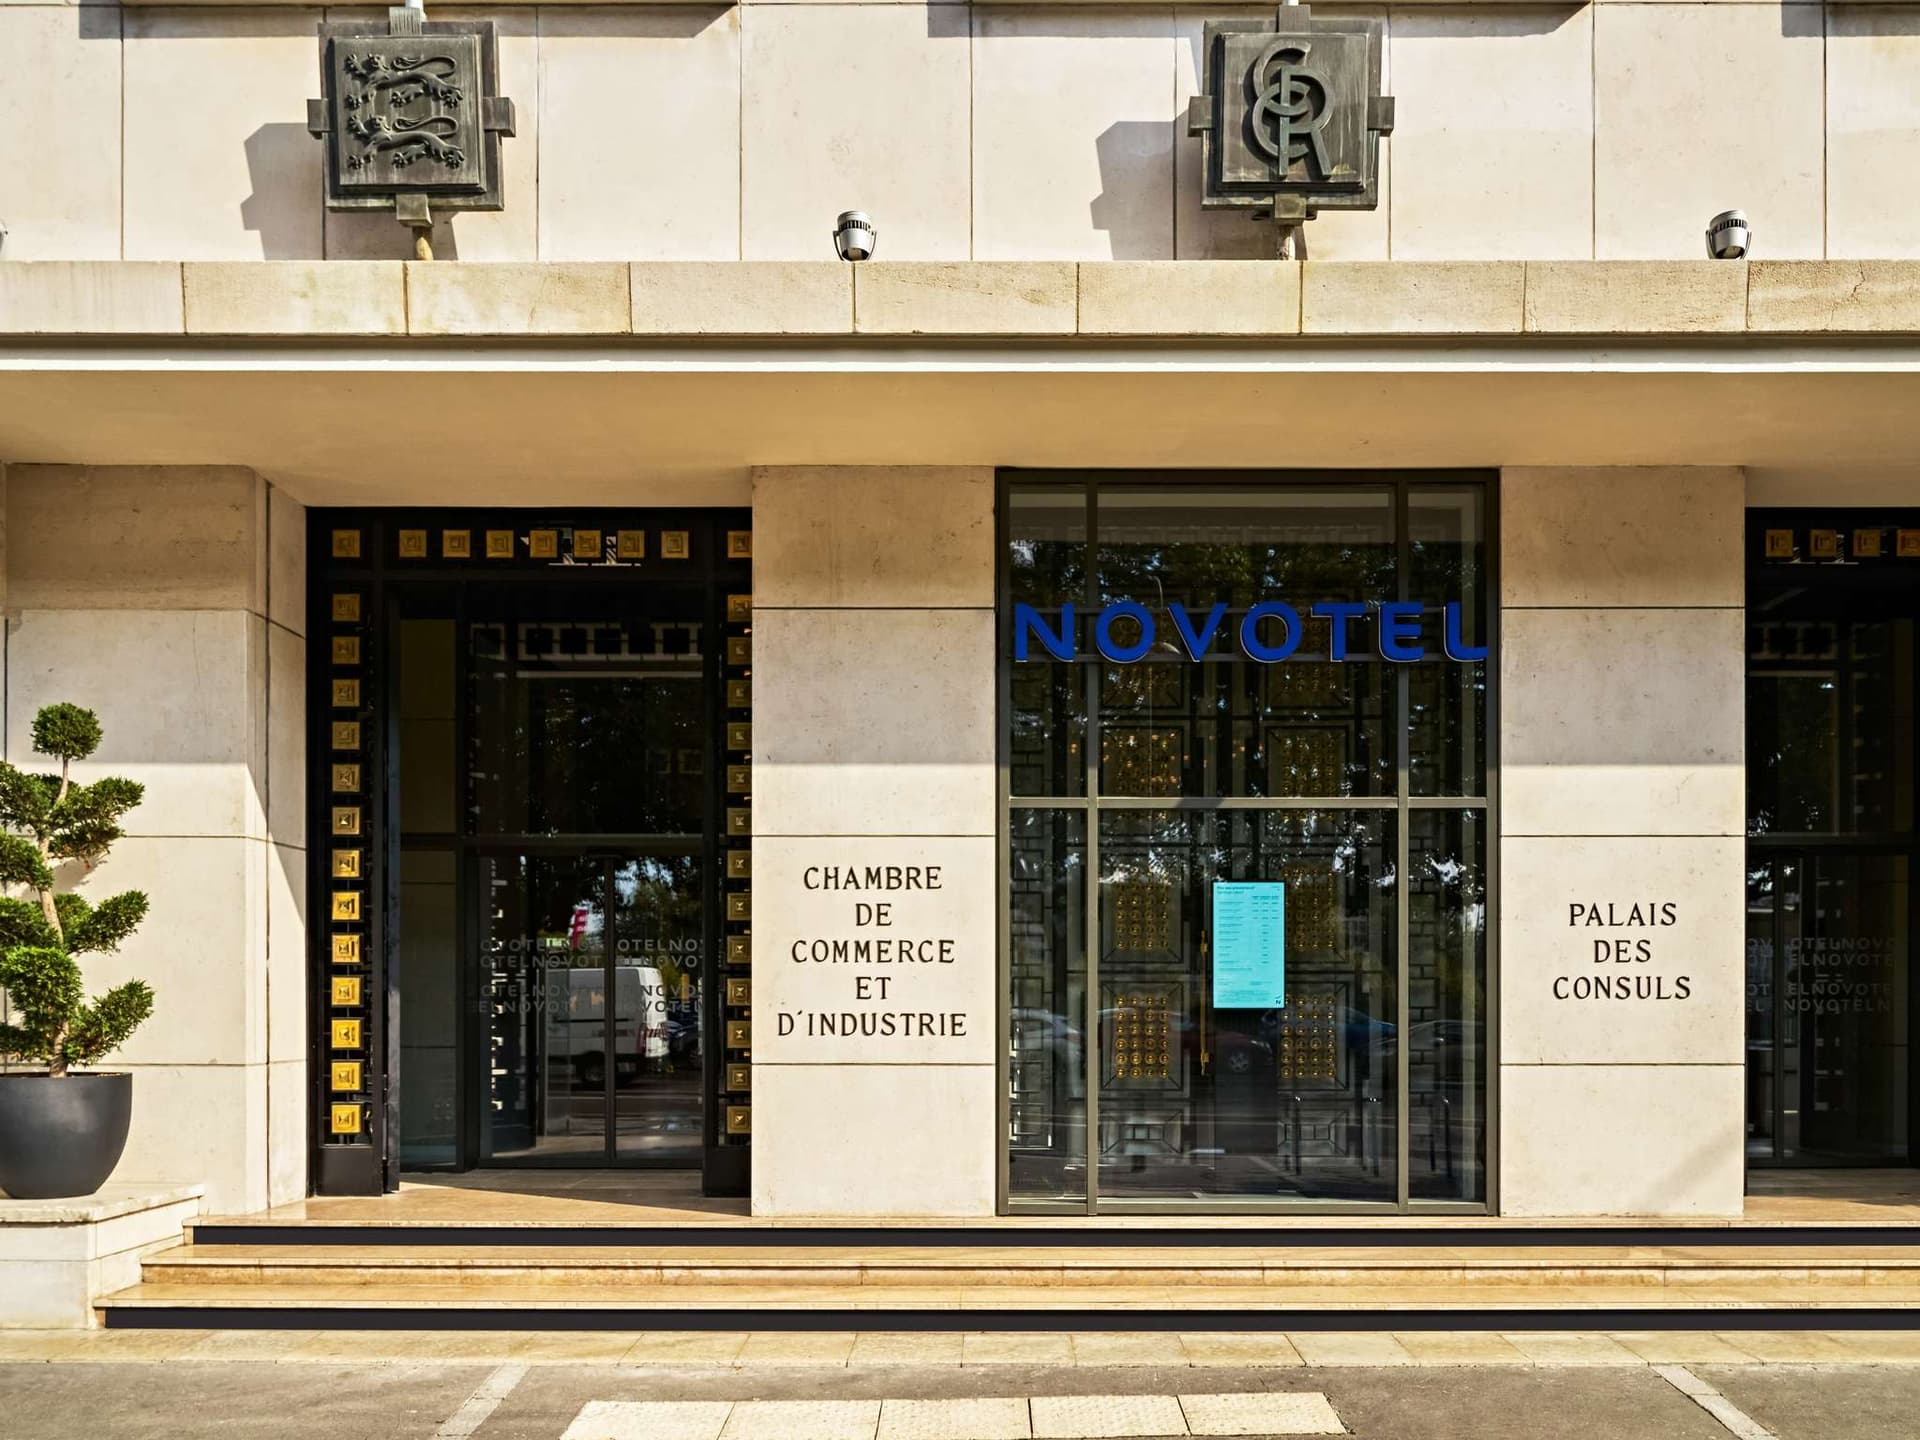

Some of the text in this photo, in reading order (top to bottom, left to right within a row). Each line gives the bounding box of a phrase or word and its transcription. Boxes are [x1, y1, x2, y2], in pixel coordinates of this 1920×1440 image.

[1014, 601, 1489, 663] NOVOTEL
[803, 866, 943, 890] CHAMBRE
[855, 903, 893, 926] DE
[1569, 902, 1677, 927] PALAIS
[791, 940, 955, 963] COMMERCE
[1594, 939, 1652, 963] DES
[855, 976, 892, 1000] ET
[1553, 976, 1691, 1000] CONSULS
[777, 1010, 968, 1036] D'INDUSTRIE
